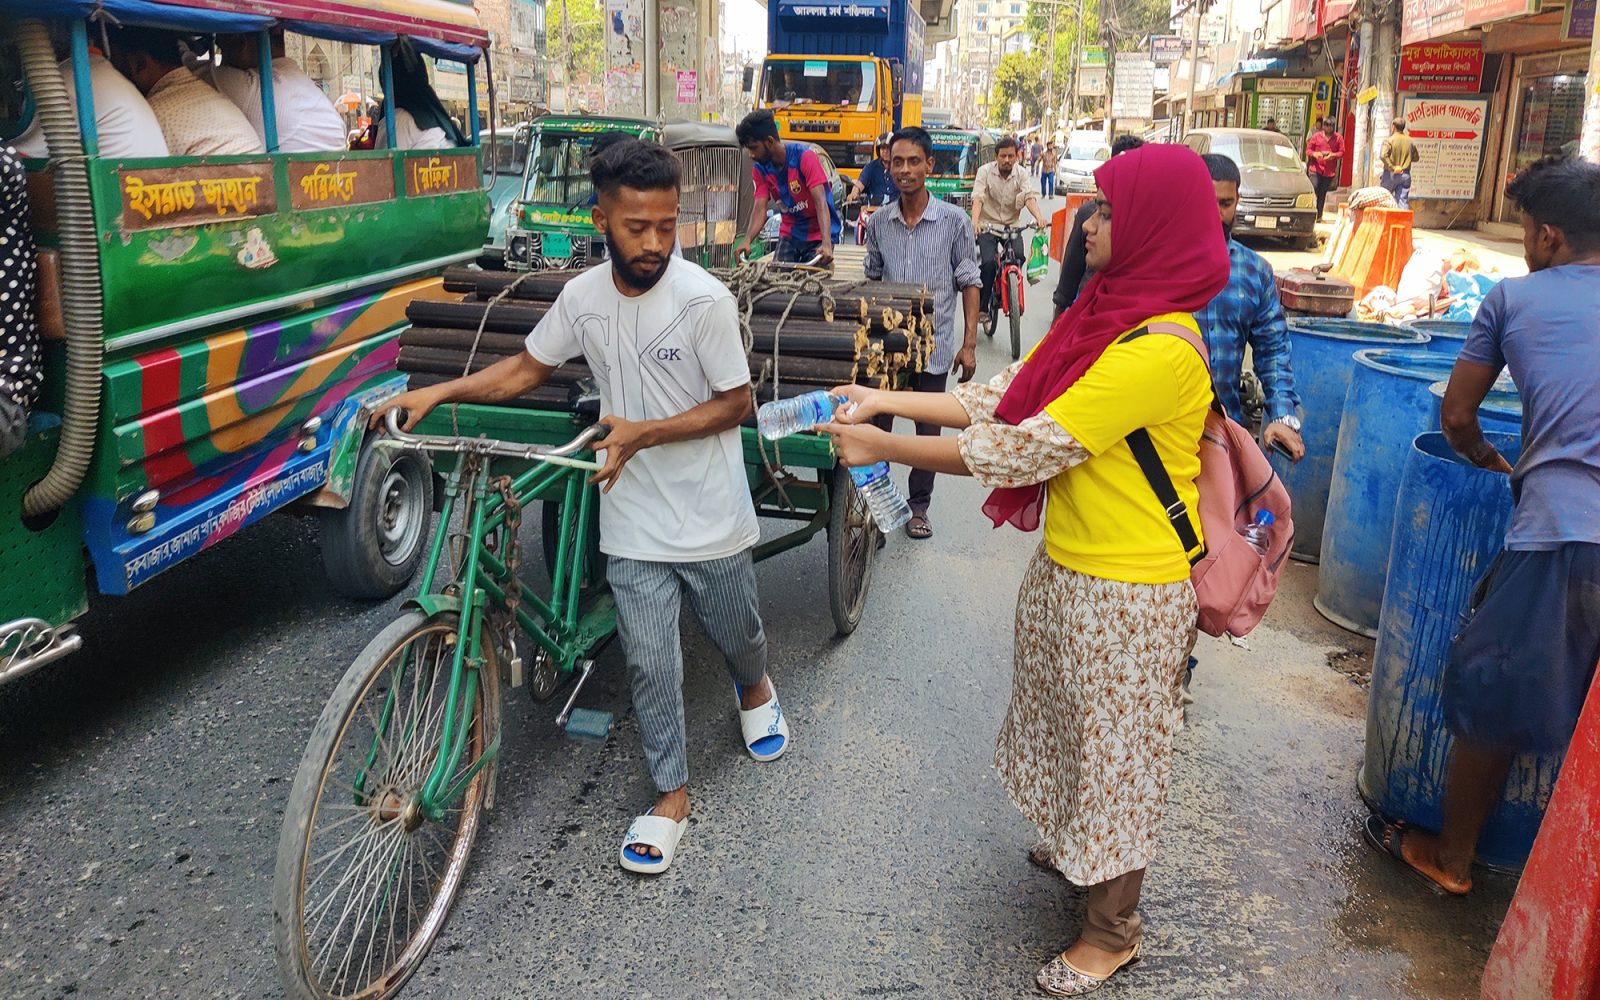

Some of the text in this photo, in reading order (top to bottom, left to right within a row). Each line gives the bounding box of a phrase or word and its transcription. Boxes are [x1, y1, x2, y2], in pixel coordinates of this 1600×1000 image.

[125, 175, 197, 220] ইসরাত
[200, 176, 263, 216] জাহান
[656, 348, 681, 360] GK
